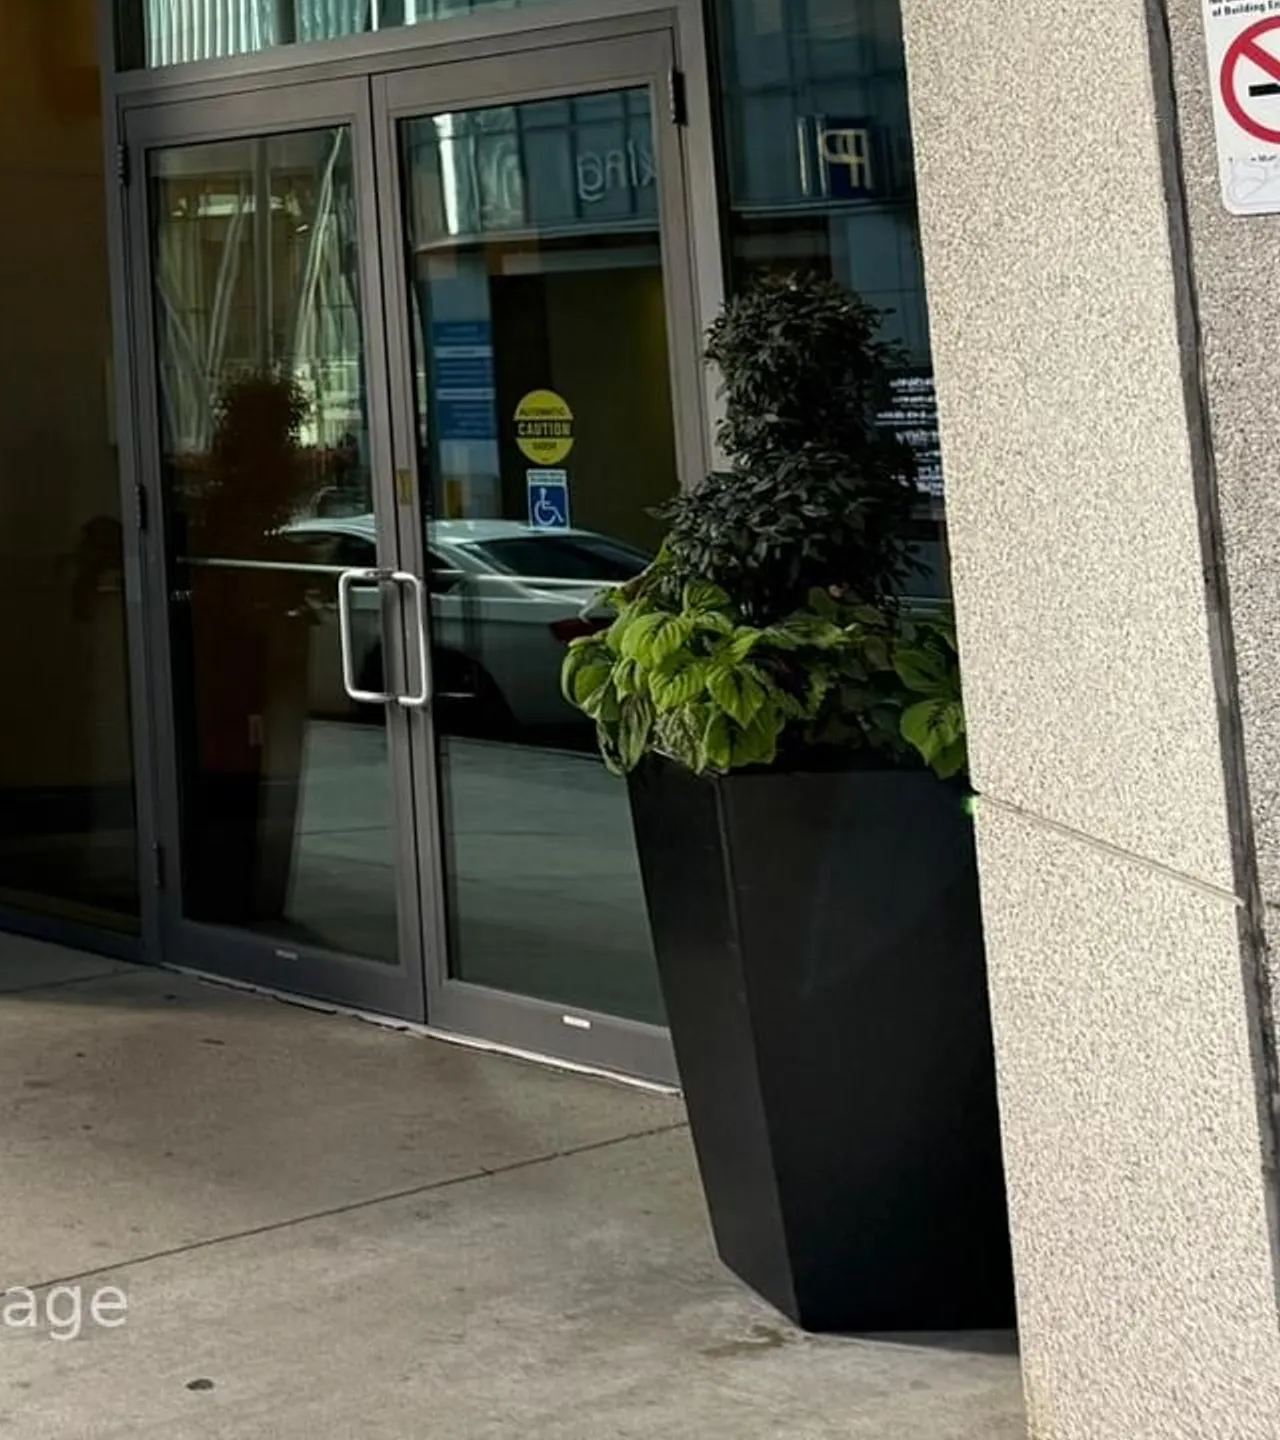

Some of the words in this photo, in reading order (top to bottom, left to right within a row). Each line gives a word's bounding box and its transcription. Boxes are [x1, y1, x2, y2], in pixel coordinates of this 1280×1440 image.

[1212, 6, 1221, 17] of
[1224, 3, 1266, 16] Building
[517, 421, 572, 436] CAUTION
